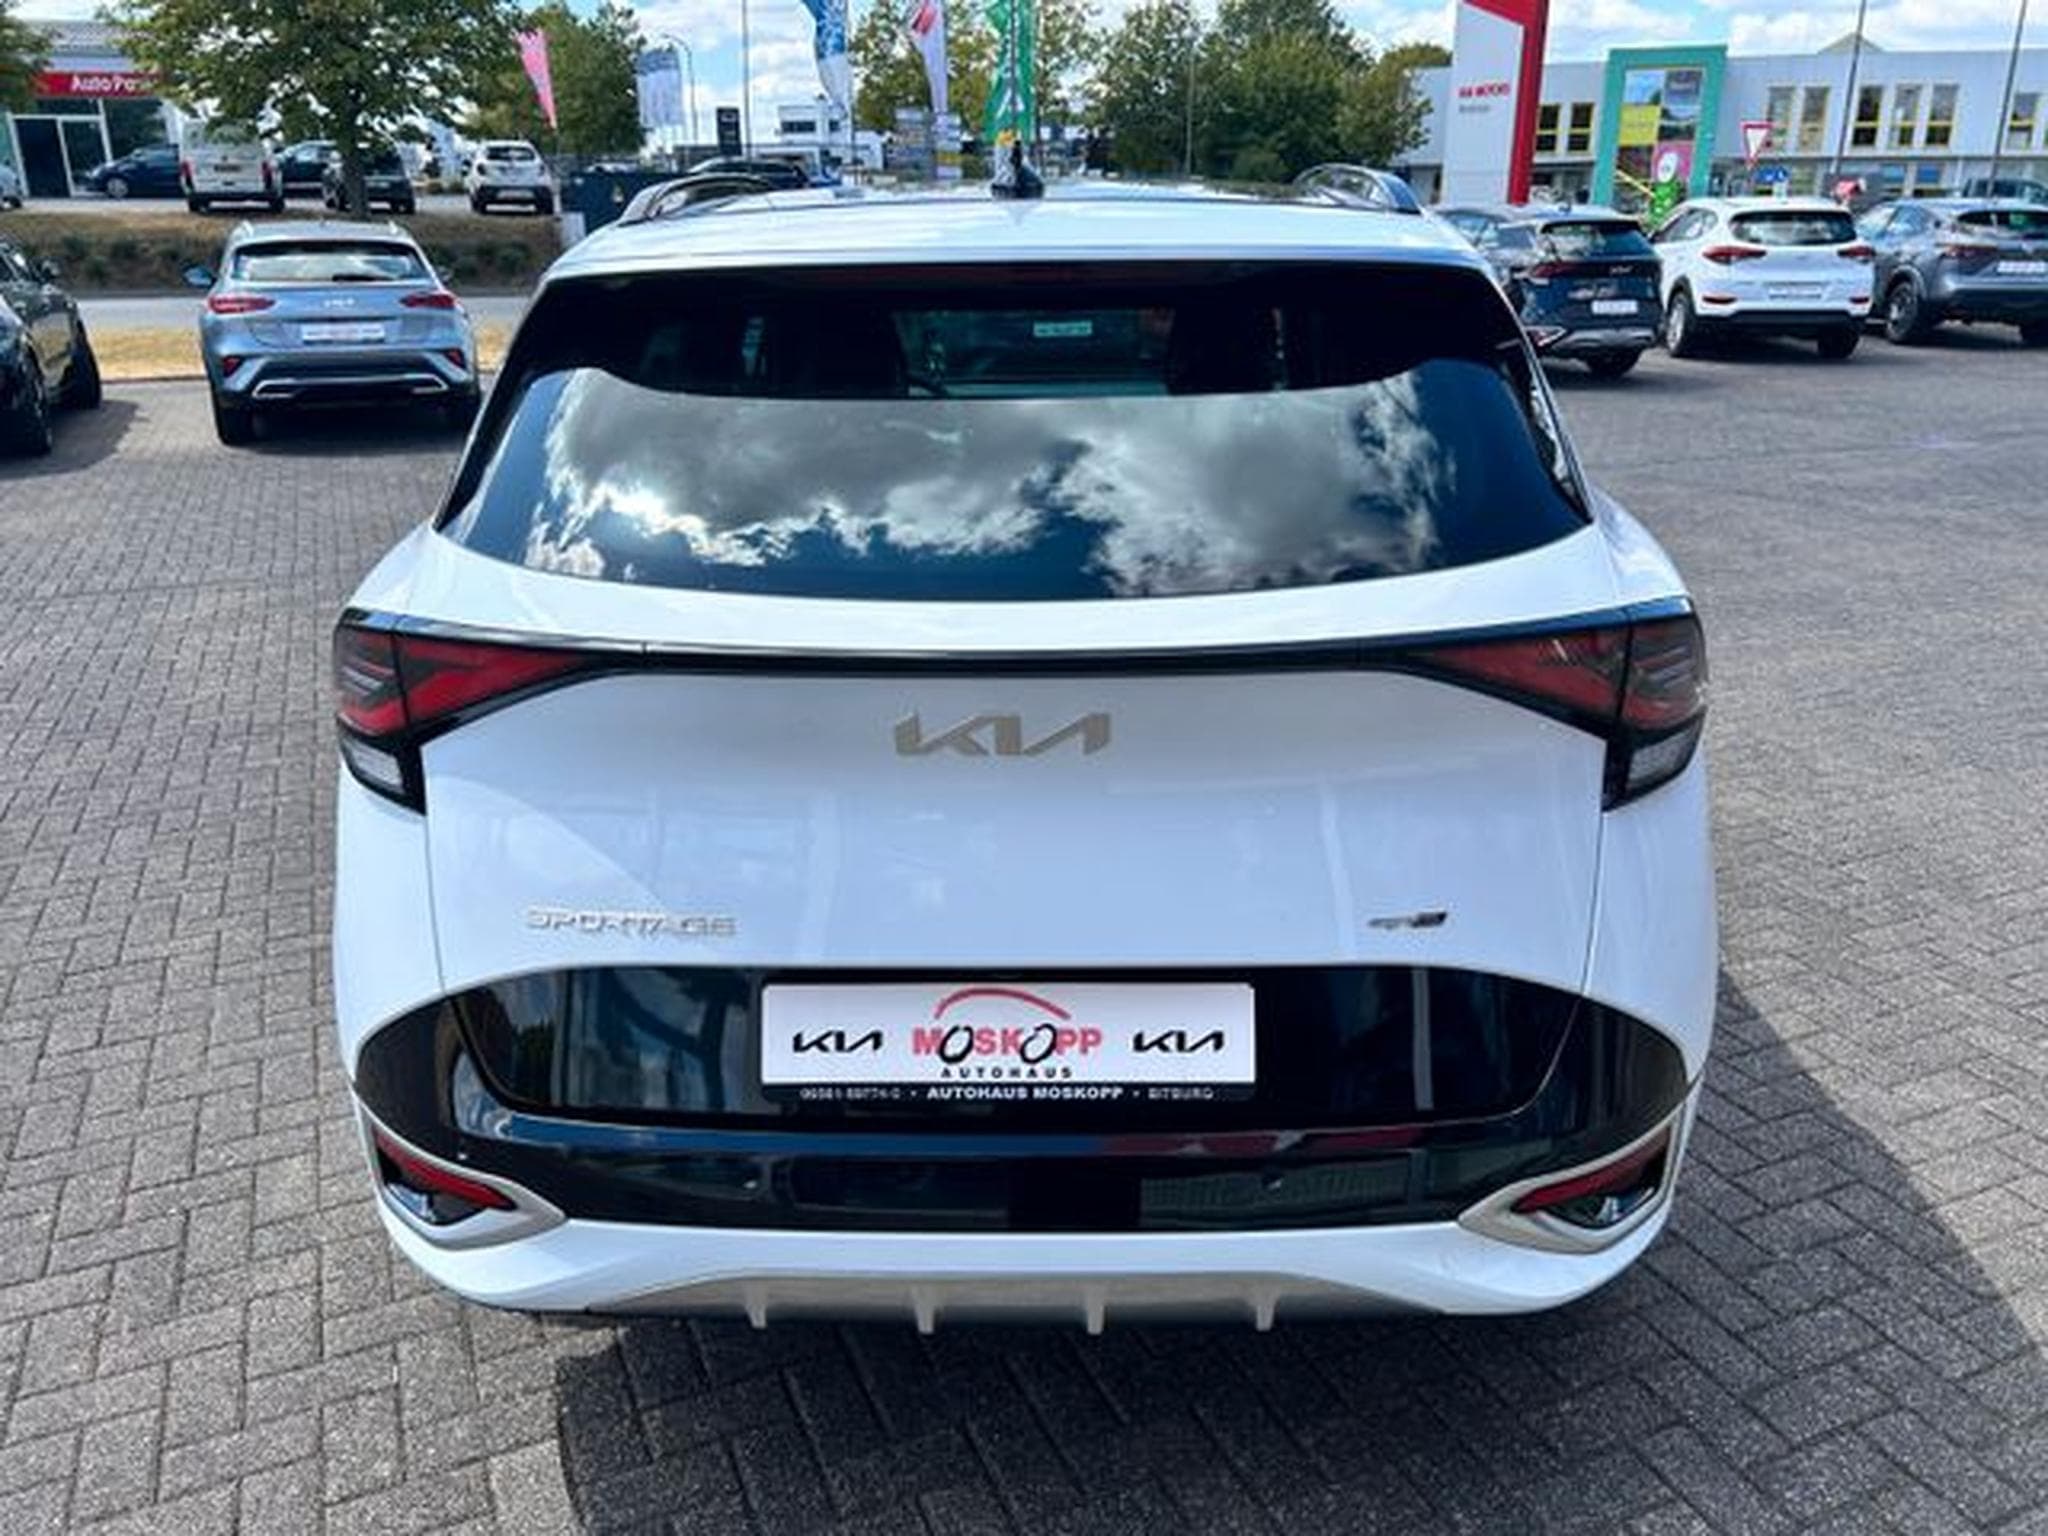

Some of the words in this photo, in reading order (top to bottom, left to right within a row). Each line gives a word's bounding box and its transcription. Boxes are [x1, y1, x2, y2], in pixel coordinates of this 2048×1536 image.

[894, 713, 1111, 756] KIA
[792, 1030, 883, 1054] KIA
[911, 1022, 1101, 1065] MOSKOPP
[1132, 1030, 1225, 1054] KIA
[940, 1066, 1073, 1079] AUTOHAUS
[926, 1086, 1028, 1100] AUTOHAUS
[1032, 1086, 1124, 1099] MOSKOPP
